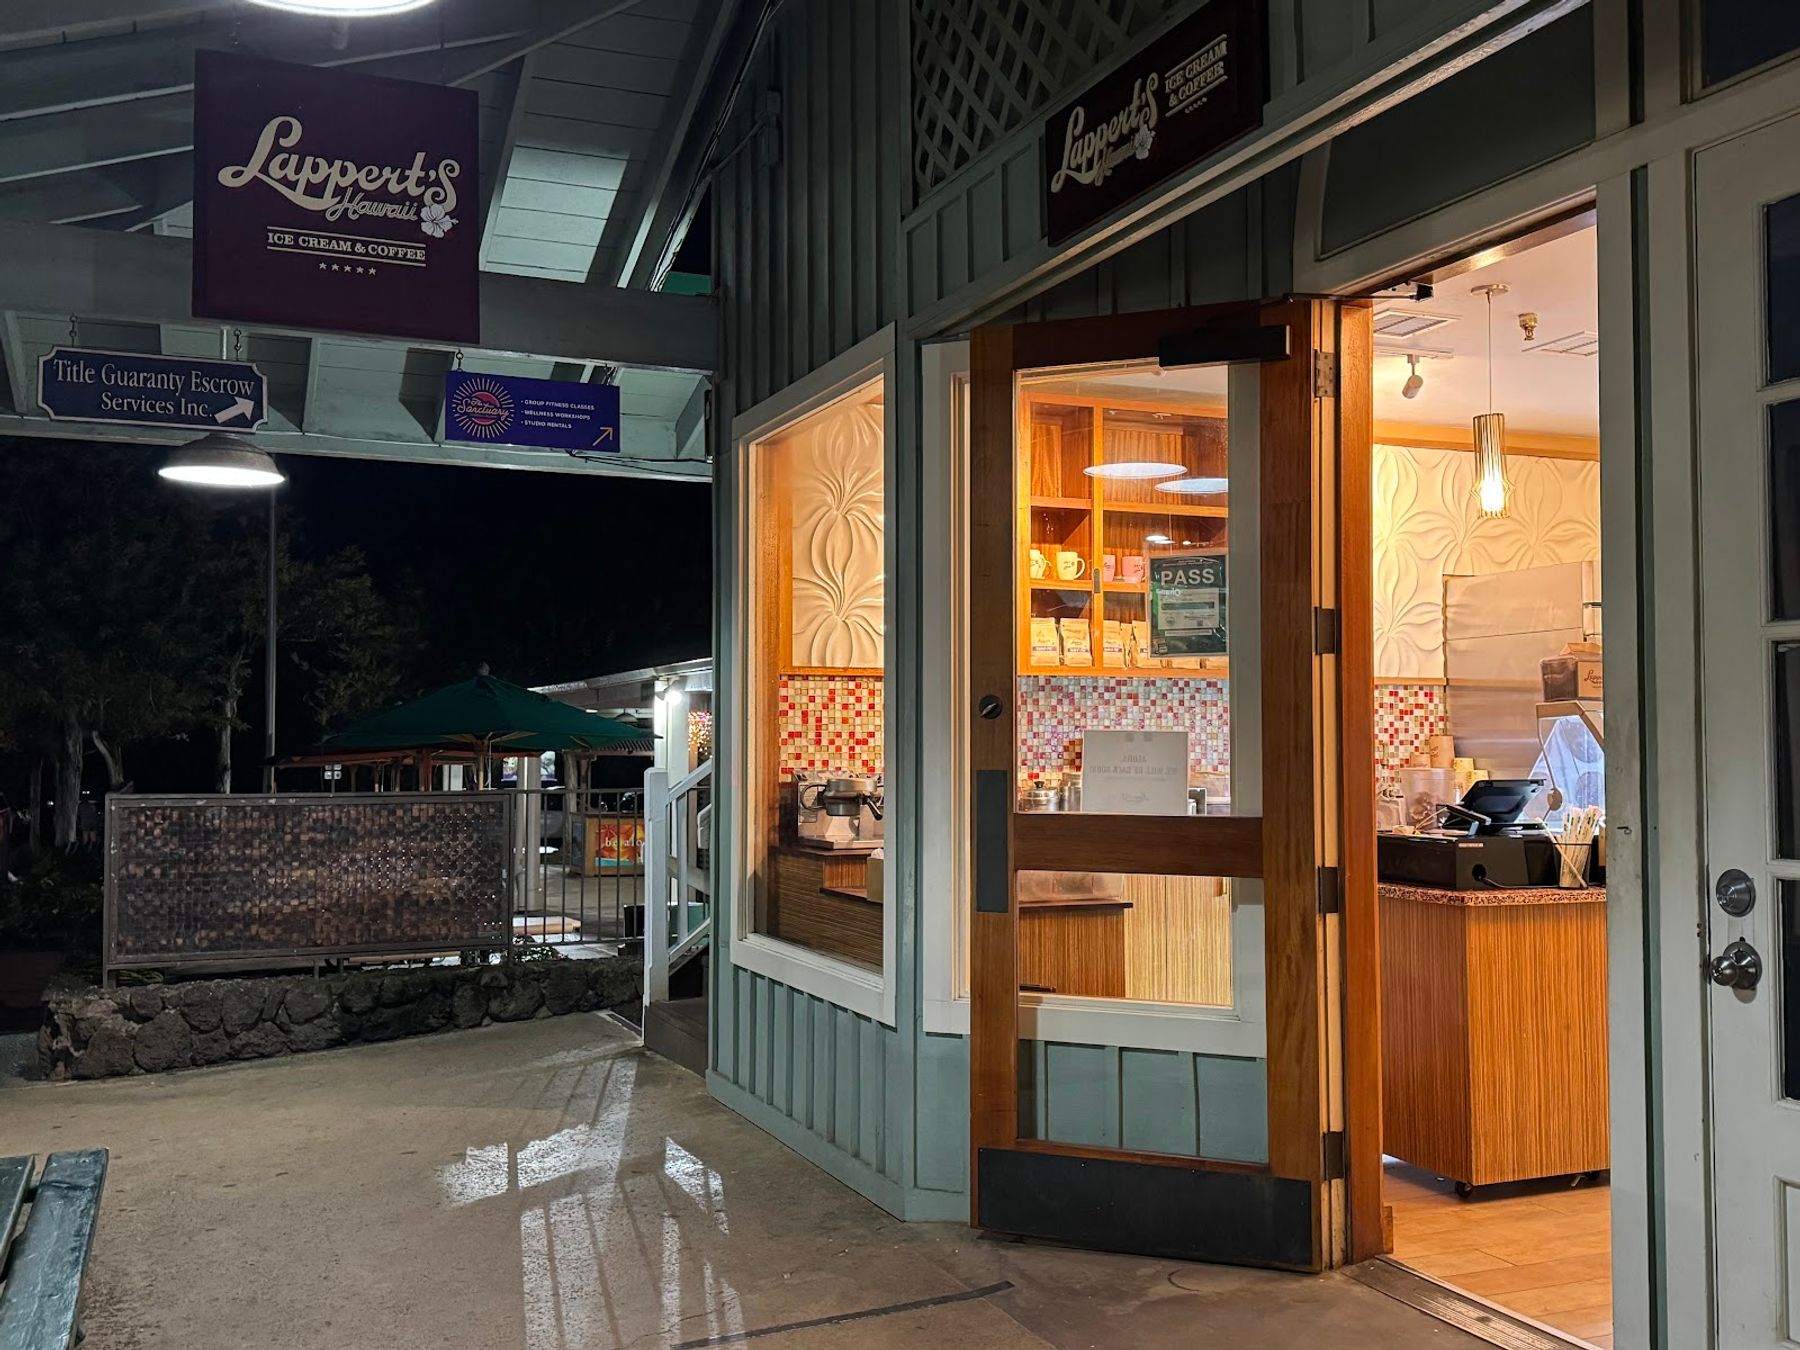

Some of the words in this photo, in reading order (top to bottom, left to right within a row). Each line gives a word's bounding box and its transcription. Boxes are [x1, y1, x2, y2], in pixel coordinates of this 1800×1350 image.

[1164, 70, 1185, 93] ICE
[1185, 41, 1228, 78] CREAM
[1168, 93, 1180, 107] &
[1178, 61, 1225, 100] COFFEE
[325, 187, 419, 222] Hawaii
[267, 232, 294, 246] ICE
[298, 235, 352, 252] CREAM
[354, 242, 367, 254] &
[367, 245, 426, 261] COFFEE
[54, 359, 96, 384] Title
[101, 363, 186, 396] Guaranty
[190, 370, 255, 396] Escrow
[101, 392, 175, 415] Services
[180, 398, 213, 418] Inc.
[456, 398, 510, 422] Sanctuary
[524, 409, 554, 418] WELLNESS
[554, 412, 591, 420] WORKSHOPS
[569, 403, 595, 411] CLASSES
[1160, 567, 1216, 587] PASS
